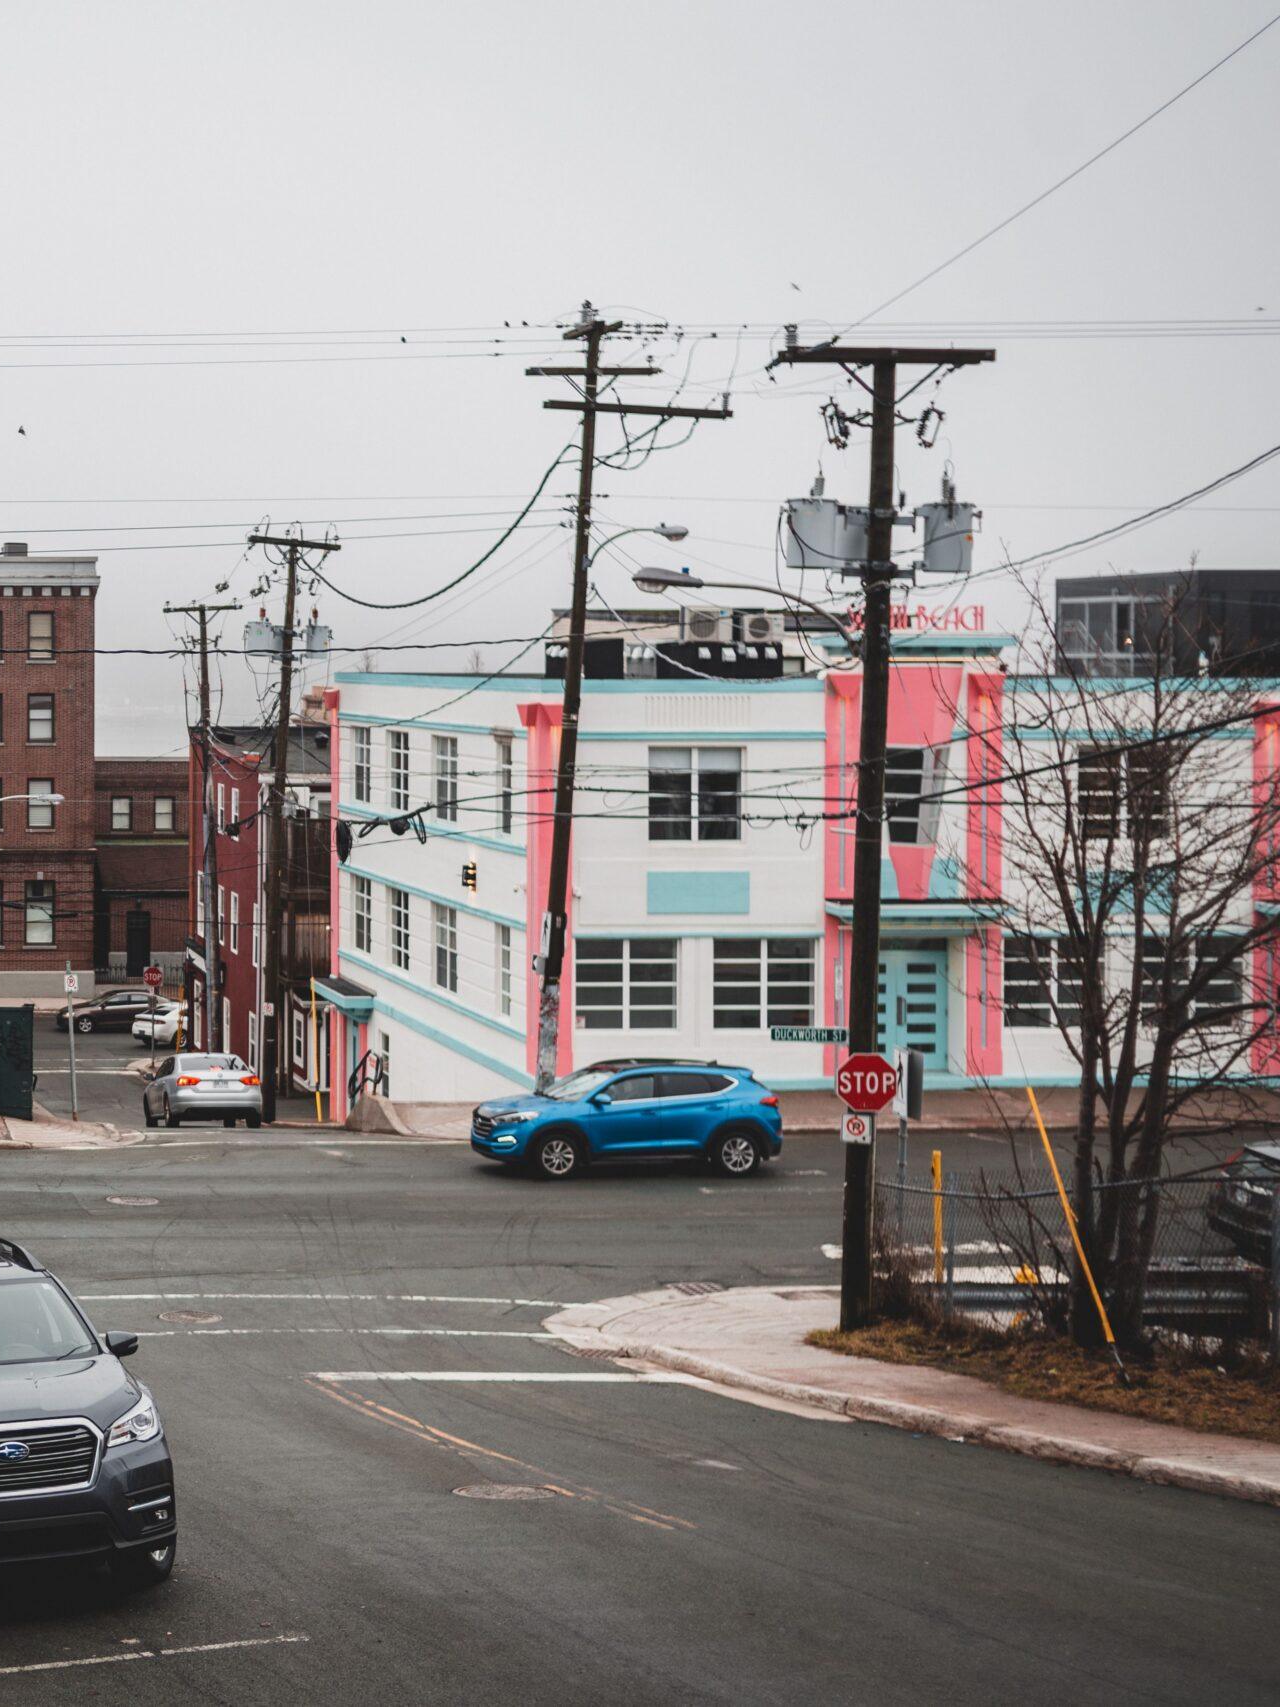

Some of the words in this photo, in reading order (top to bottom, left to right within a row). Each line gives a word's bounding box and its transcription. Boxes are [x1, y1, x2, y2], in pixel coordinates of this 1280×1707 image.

[916, 605, 984, 631] BEACH
[144, 973, 162, 981] STOP
[774, 1028, 827, 1042] DUCKWORTH
[832, 1028, 842, 1042] ST
[840, 1072, 895, 1094] STOP
